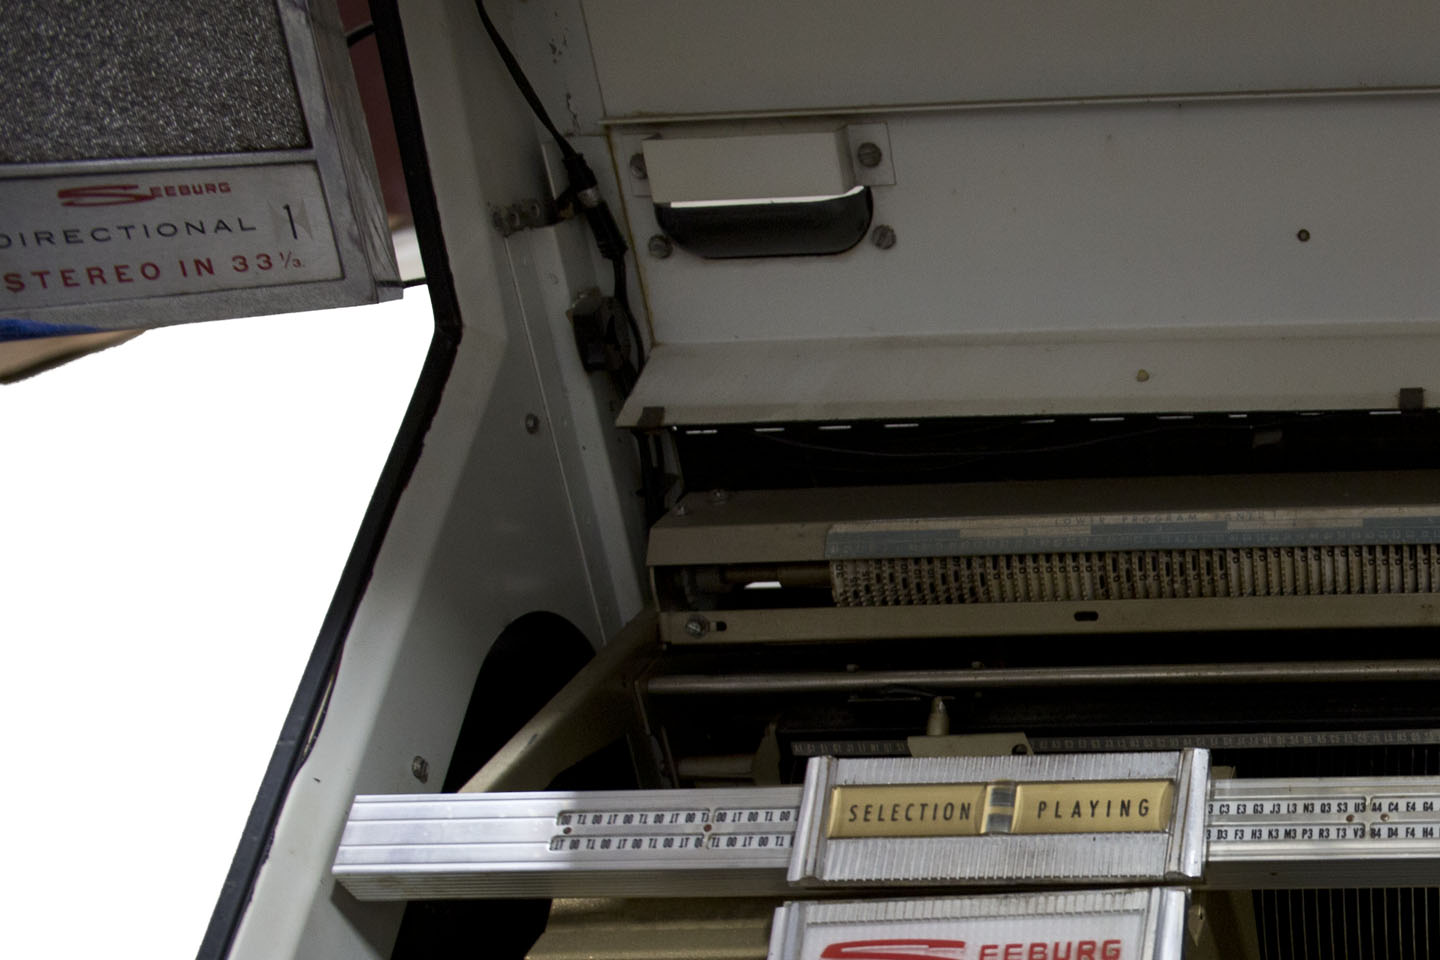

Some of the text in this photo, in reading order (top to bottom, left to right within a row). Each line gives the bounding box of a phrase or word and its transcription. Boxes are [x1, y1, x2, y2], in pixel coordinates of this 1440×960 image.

[57, 182, 231, 207] SEEBURG
[283, 203, 298, 240] 1
[3, 262, 160, 293] STEREO
[179, 257, 214, 278] IN
[848, 799, 1151, 822] SELECTION PLAYING
[1219, 804, 1230, 814] C3
[1237, 803, 1246, 814] E3
[1270, 803, 1280, 814] J3
[1287, 803, 1297, 813] L3
[1303, 803, 1314, 813] N3
[1337, 803, 1347, 813] S3
[1354, 802, 1366, 813] U3
[1388, 802, 1398, 812] C4
[1406, 802, 1416, 812] E4
[1217, 829, 1228, 840] D3
[1234, 829, 1244, 840] F3
[1251, 829, 1262, 839] H3
[1268, 829, 1279, 839] K3
[1284, 829, 1297, 839] M3
[1302, 828, 1313, 839] P3
[1319, 828, 1330, 839] R3
[1336, 828, 1347, 838] T3
[1387, 827, 1398, 838] D4
[1406, 827, 1415, 838] F4
[1422, 827, 1433, 837] H4
